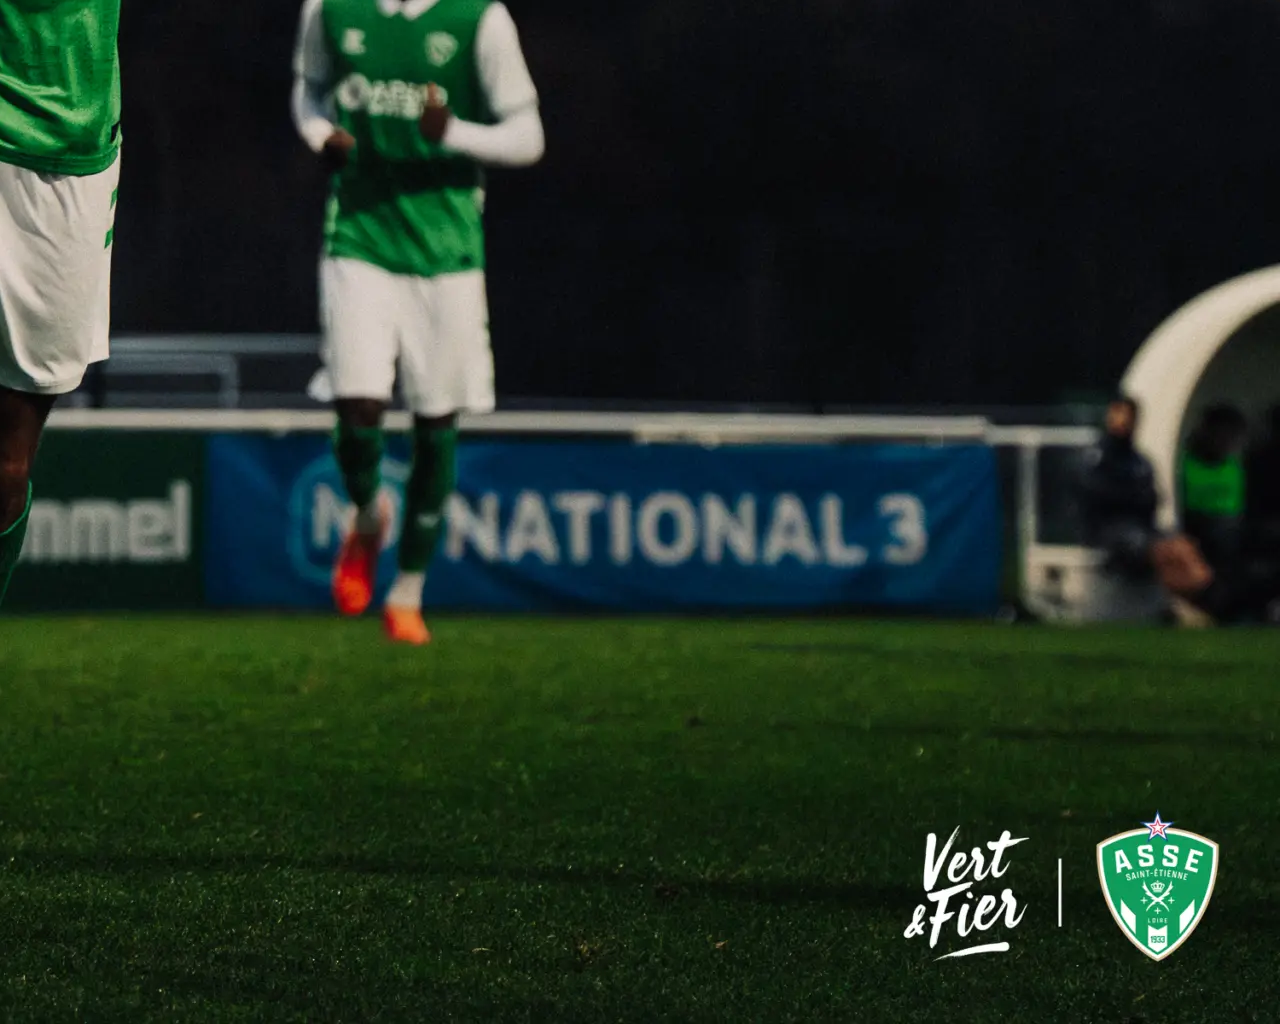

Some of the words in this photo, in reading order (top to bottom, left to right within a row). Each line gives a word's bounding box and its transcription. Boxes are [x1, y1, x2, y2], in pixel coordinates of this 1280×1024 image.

[18, 479, 194, 564] mmel
[443, 487, 868, 568] NATIONAL
[876, 491, 928, 567] 3
